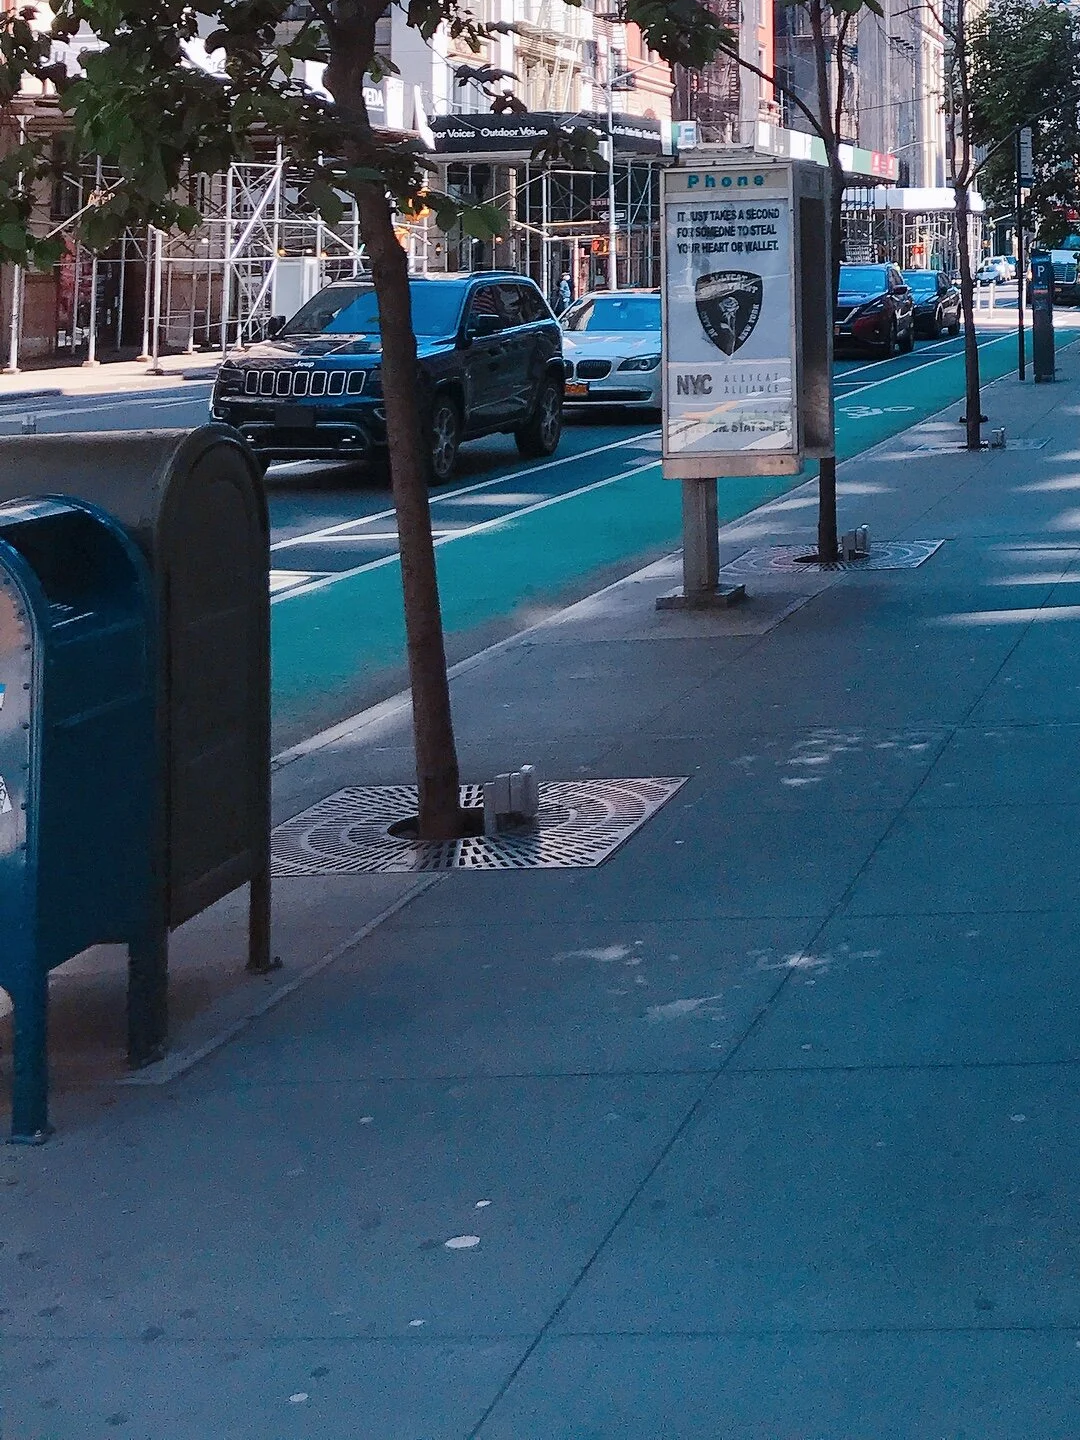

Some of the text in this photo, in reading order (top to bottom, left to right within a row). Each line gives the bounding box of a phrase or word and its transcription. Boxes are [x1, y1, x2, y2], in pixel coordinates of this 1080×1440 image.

[447, 128, 475, 138] Voices
[480, 127, 519, 137] Outdoor
[687, 174, 765, 189] Phone
[677, 211, 686, 222] IT
[710, 209, 737, 221] TAKES
[738, 209, 745, 220] A
[746, 208, 780, 220] SECOND
[695, 225, 736, 238] SOMEONE
[737, 225, 749, 237] TO
[750, 224, 777, 236] STEAL
[701, 241, 730, 253] HEART
[731, 241, 744, 252] OR
[1037, 264, 1046, 278] P
[294, 360, 315, 368] Jeep
[677, 373, 713, 395] NYC
